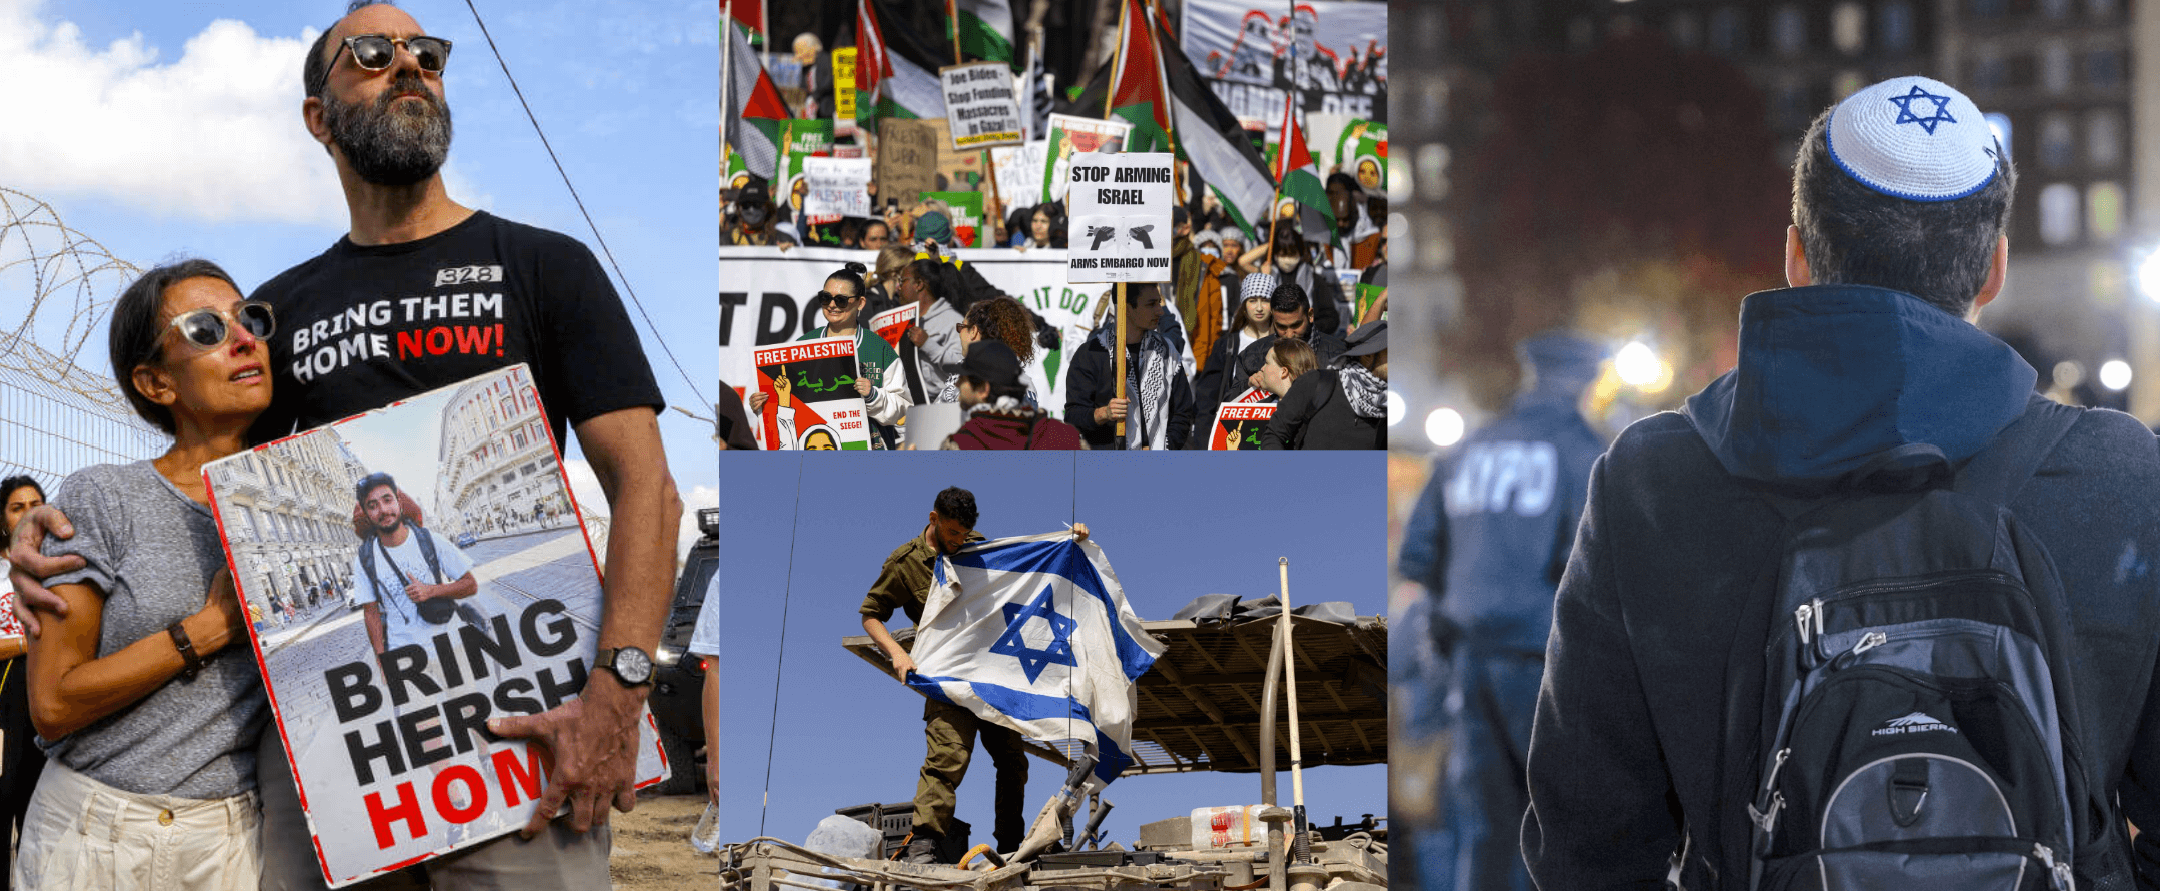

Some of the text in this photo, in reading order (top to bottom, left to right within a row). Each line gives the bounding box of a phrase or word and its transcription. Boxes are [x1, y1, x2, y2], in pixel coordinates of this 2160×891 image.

[950, 73, 967, 85] Joe
[968, 68, 998, 81] Biden
[948, 87, 1012, 105] Stop Funding
[957, 105, 1010, 120] Massacres
[968, 123, 978, 135] in
[1072, 166, 1171, 183] STOP ARMING
[1097, 188, 1145, 205] ISRAEL
[1070, 257, 1169, 269] ARMS EMBARGO NOW
[441, 267, 492, 283] 328
[1033, 287, 1089, 315] IT DO
[293, 293, 503, 355] BRING THEM
[292, 323, 504, 384] HOME NOW!
[756, 342, 854, 365] FREE PALESTINE
[797, 370, 856, 393] حرية
[833, 409, 861, 419] END THE
[1221, 407, 1273, 418] FREE PAL
[840, 420, 862, 430] SIEGE!
[323, 598, 579, 724] BRING
[343, 657, 590, 787] HERSH
[1871, 723, 1958, 736] HIGH SIERRA
[363, 743, 552, 850] HOM
